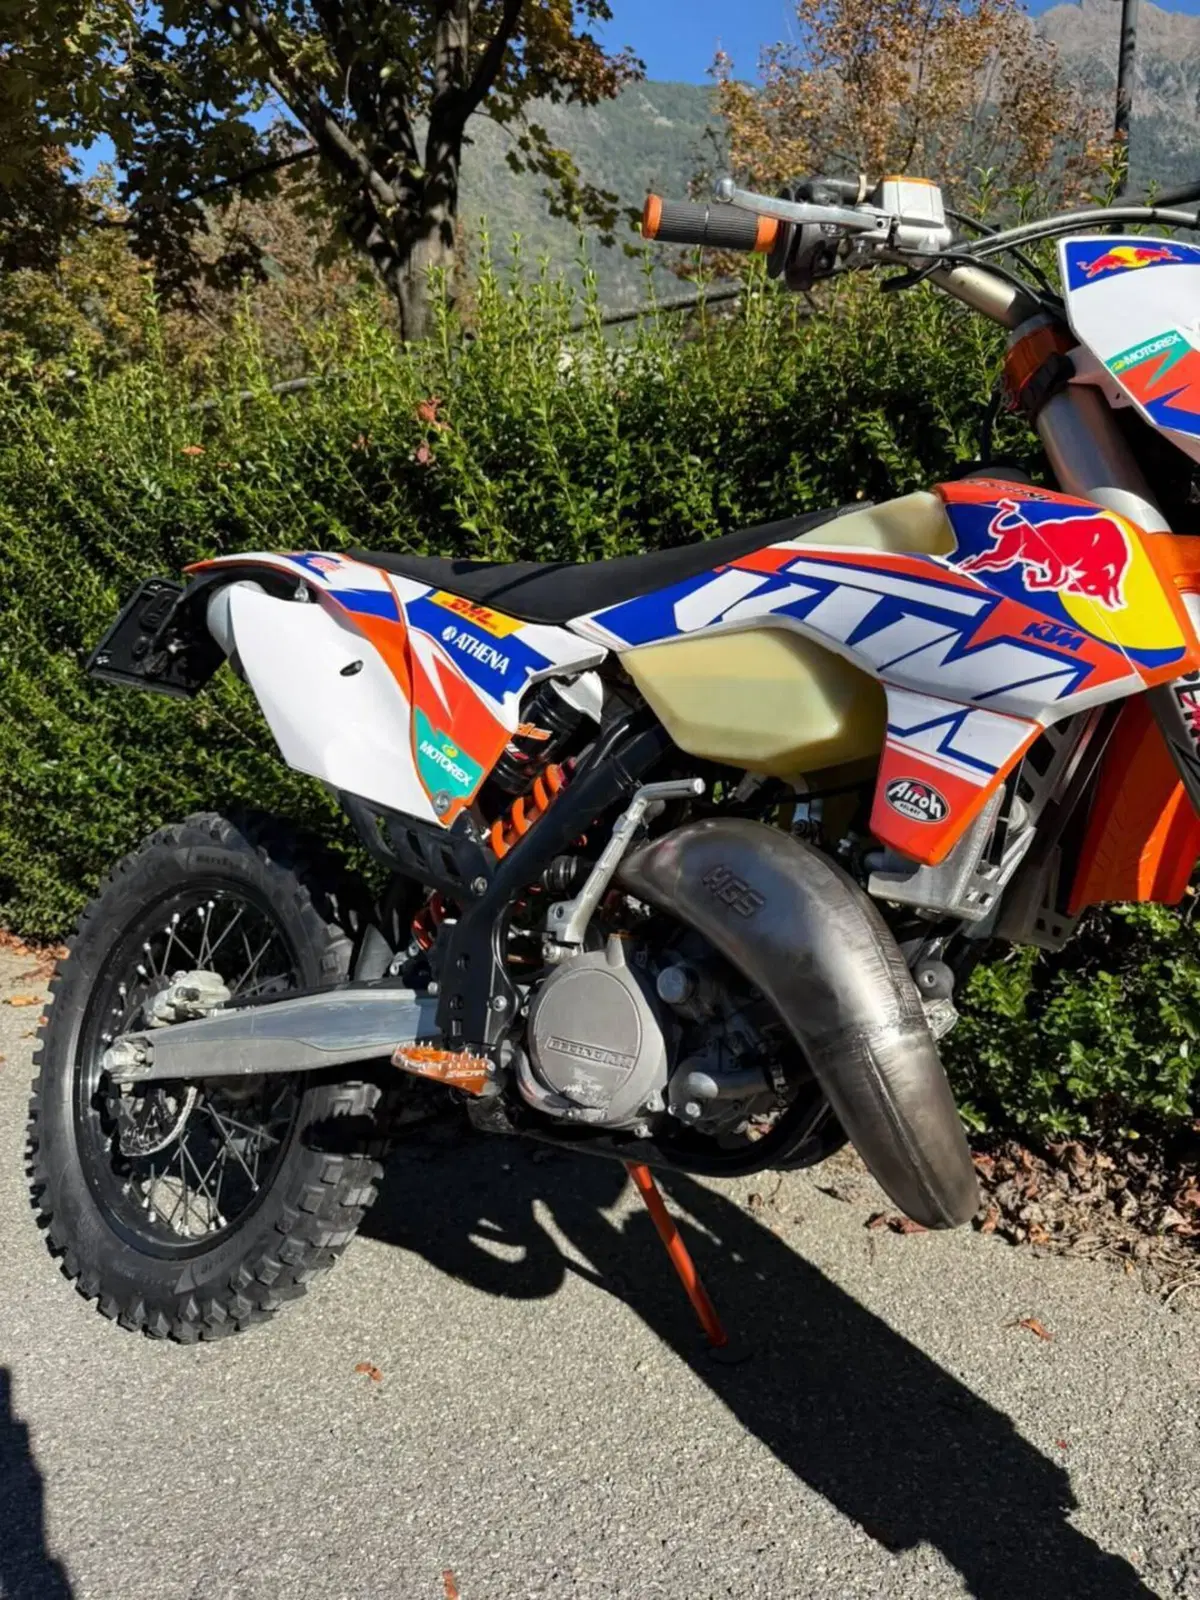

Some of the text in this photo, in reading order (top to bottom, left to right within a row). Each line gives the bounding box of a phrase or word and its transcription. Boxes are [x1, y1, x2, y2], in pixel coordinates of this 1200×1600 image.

[1123, 334, 1181, 365] MOTOREX
[455, 634, 510, 675] ATHENA
[1021, 621, 1087, 652] KTM
[420, 741, 473, 787] MOTOREX
[888, 781, 942, 818] Airoh
